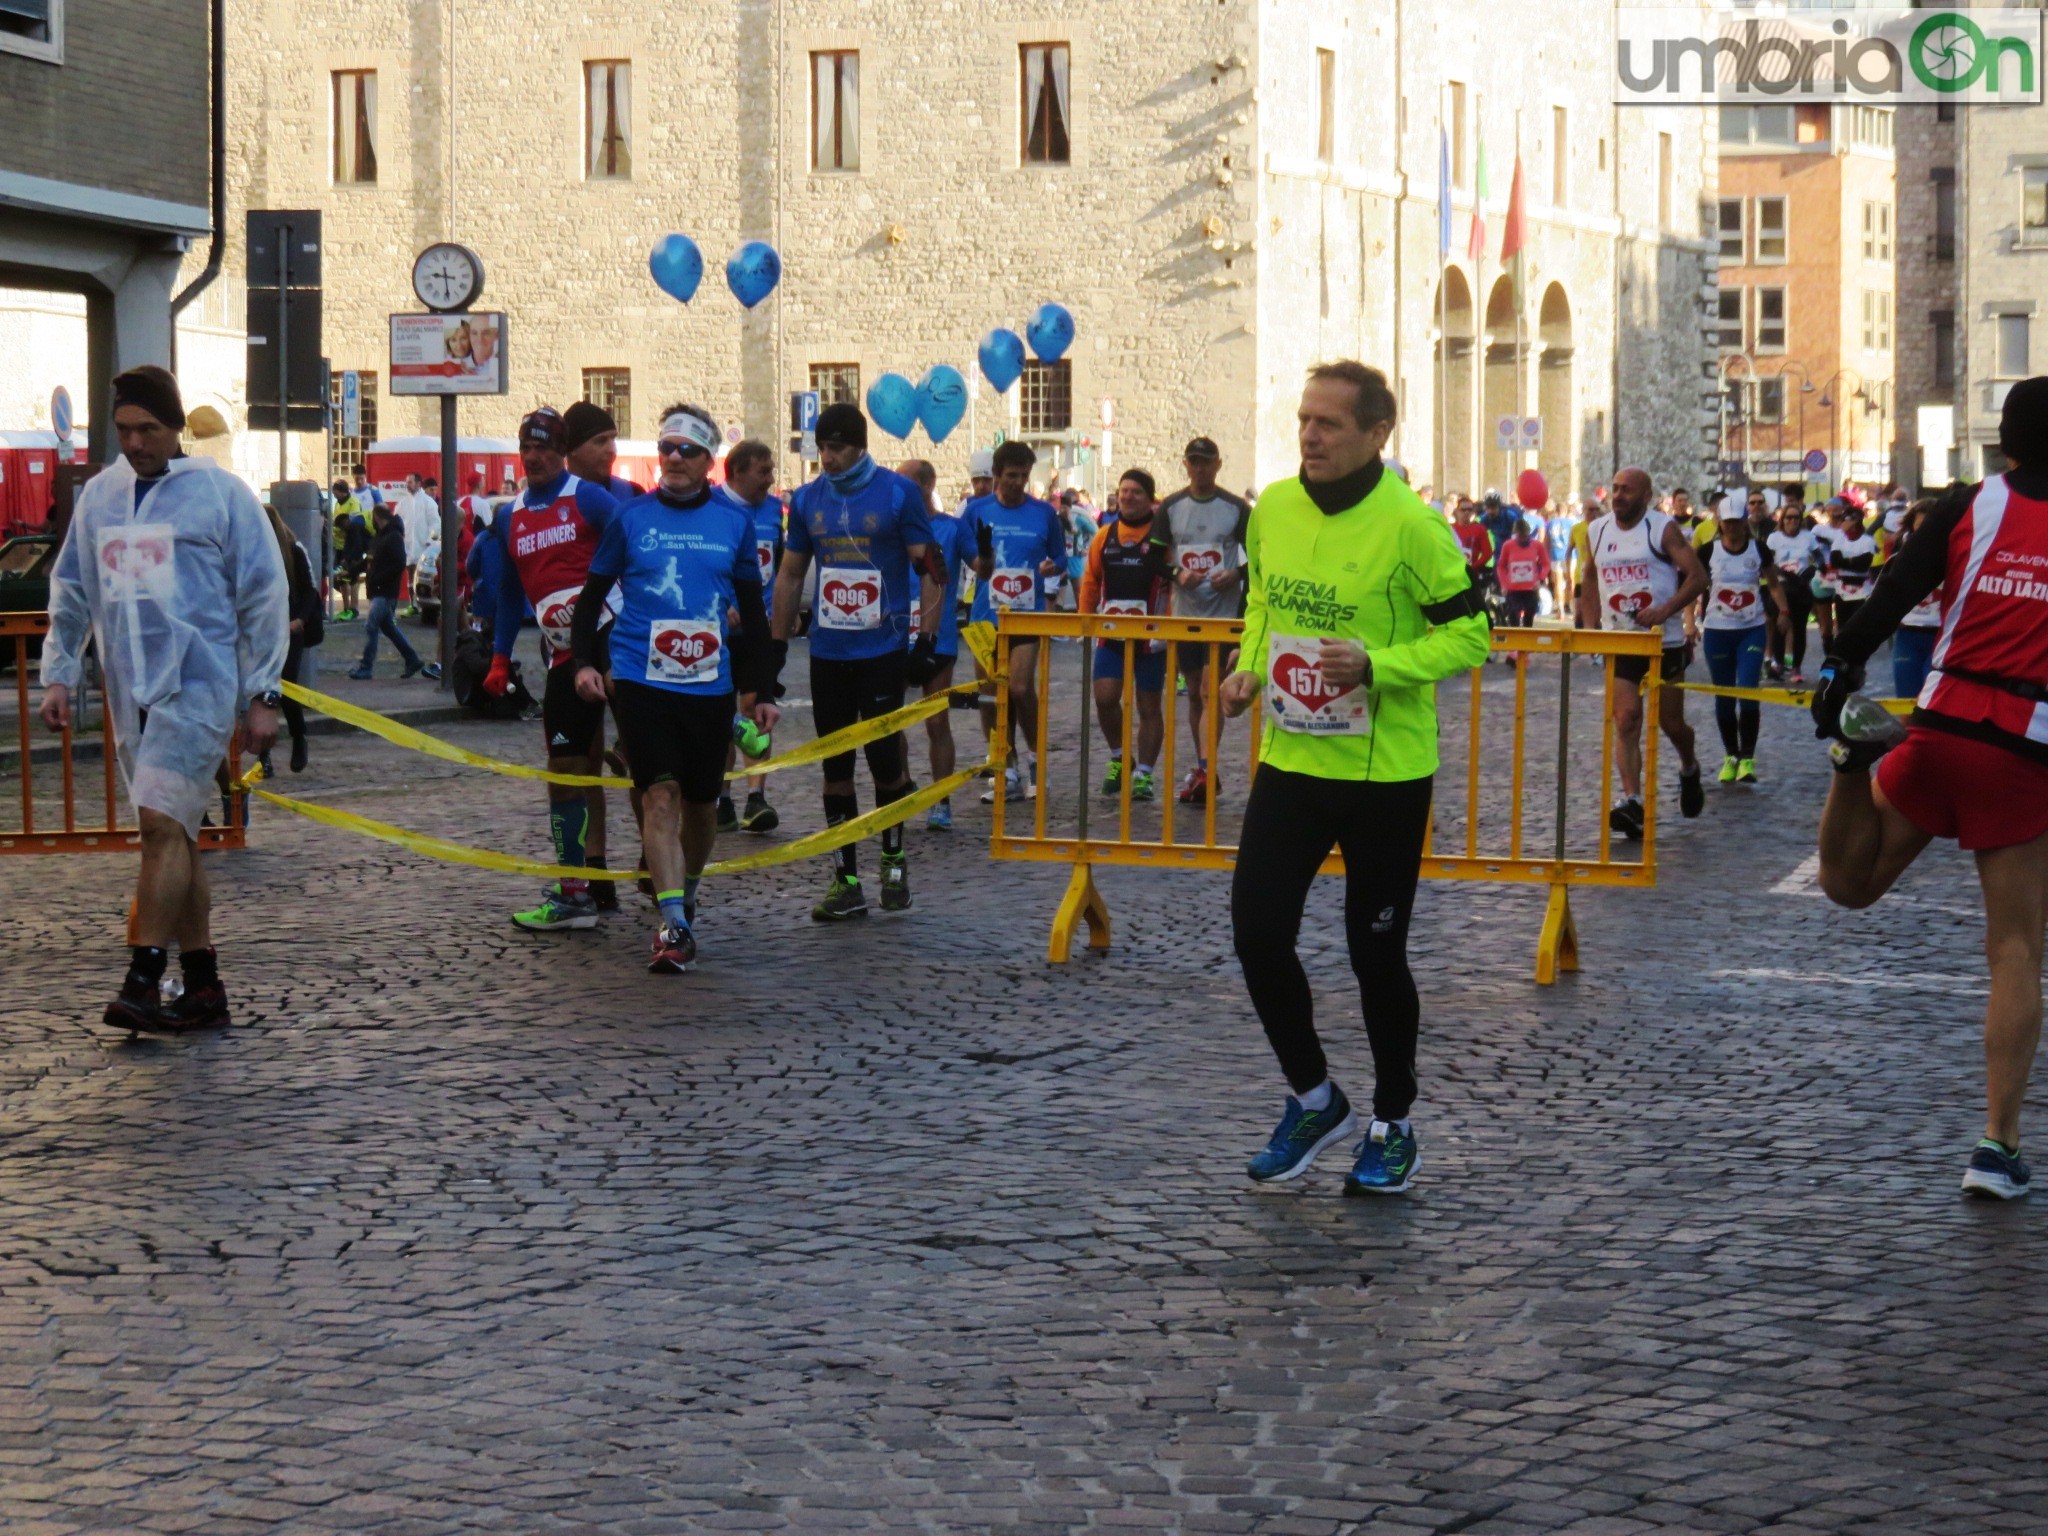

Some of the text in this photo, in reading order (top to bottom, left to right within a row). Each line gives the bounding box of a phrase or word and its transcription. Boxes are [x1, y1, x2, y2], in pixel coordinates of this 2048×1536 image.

[804, 396, 815, 428] P
[517, 523, 577, 557] FREE RUNNERS
[659, 533, 704, 541] Maratona
[667, 541, 685, 549] San
[687, 541, 729, 552] Valentino
[1002, 580, 1022, 593] 415
[1977, 575, 2013, 596] ALTO
[831, 588, 868, 606] 1996
[1268, 592, 1359, 621] RUNNERS
[1295, 614, 1336, 632] ROMA
[670, 638, 704, 658] 296
